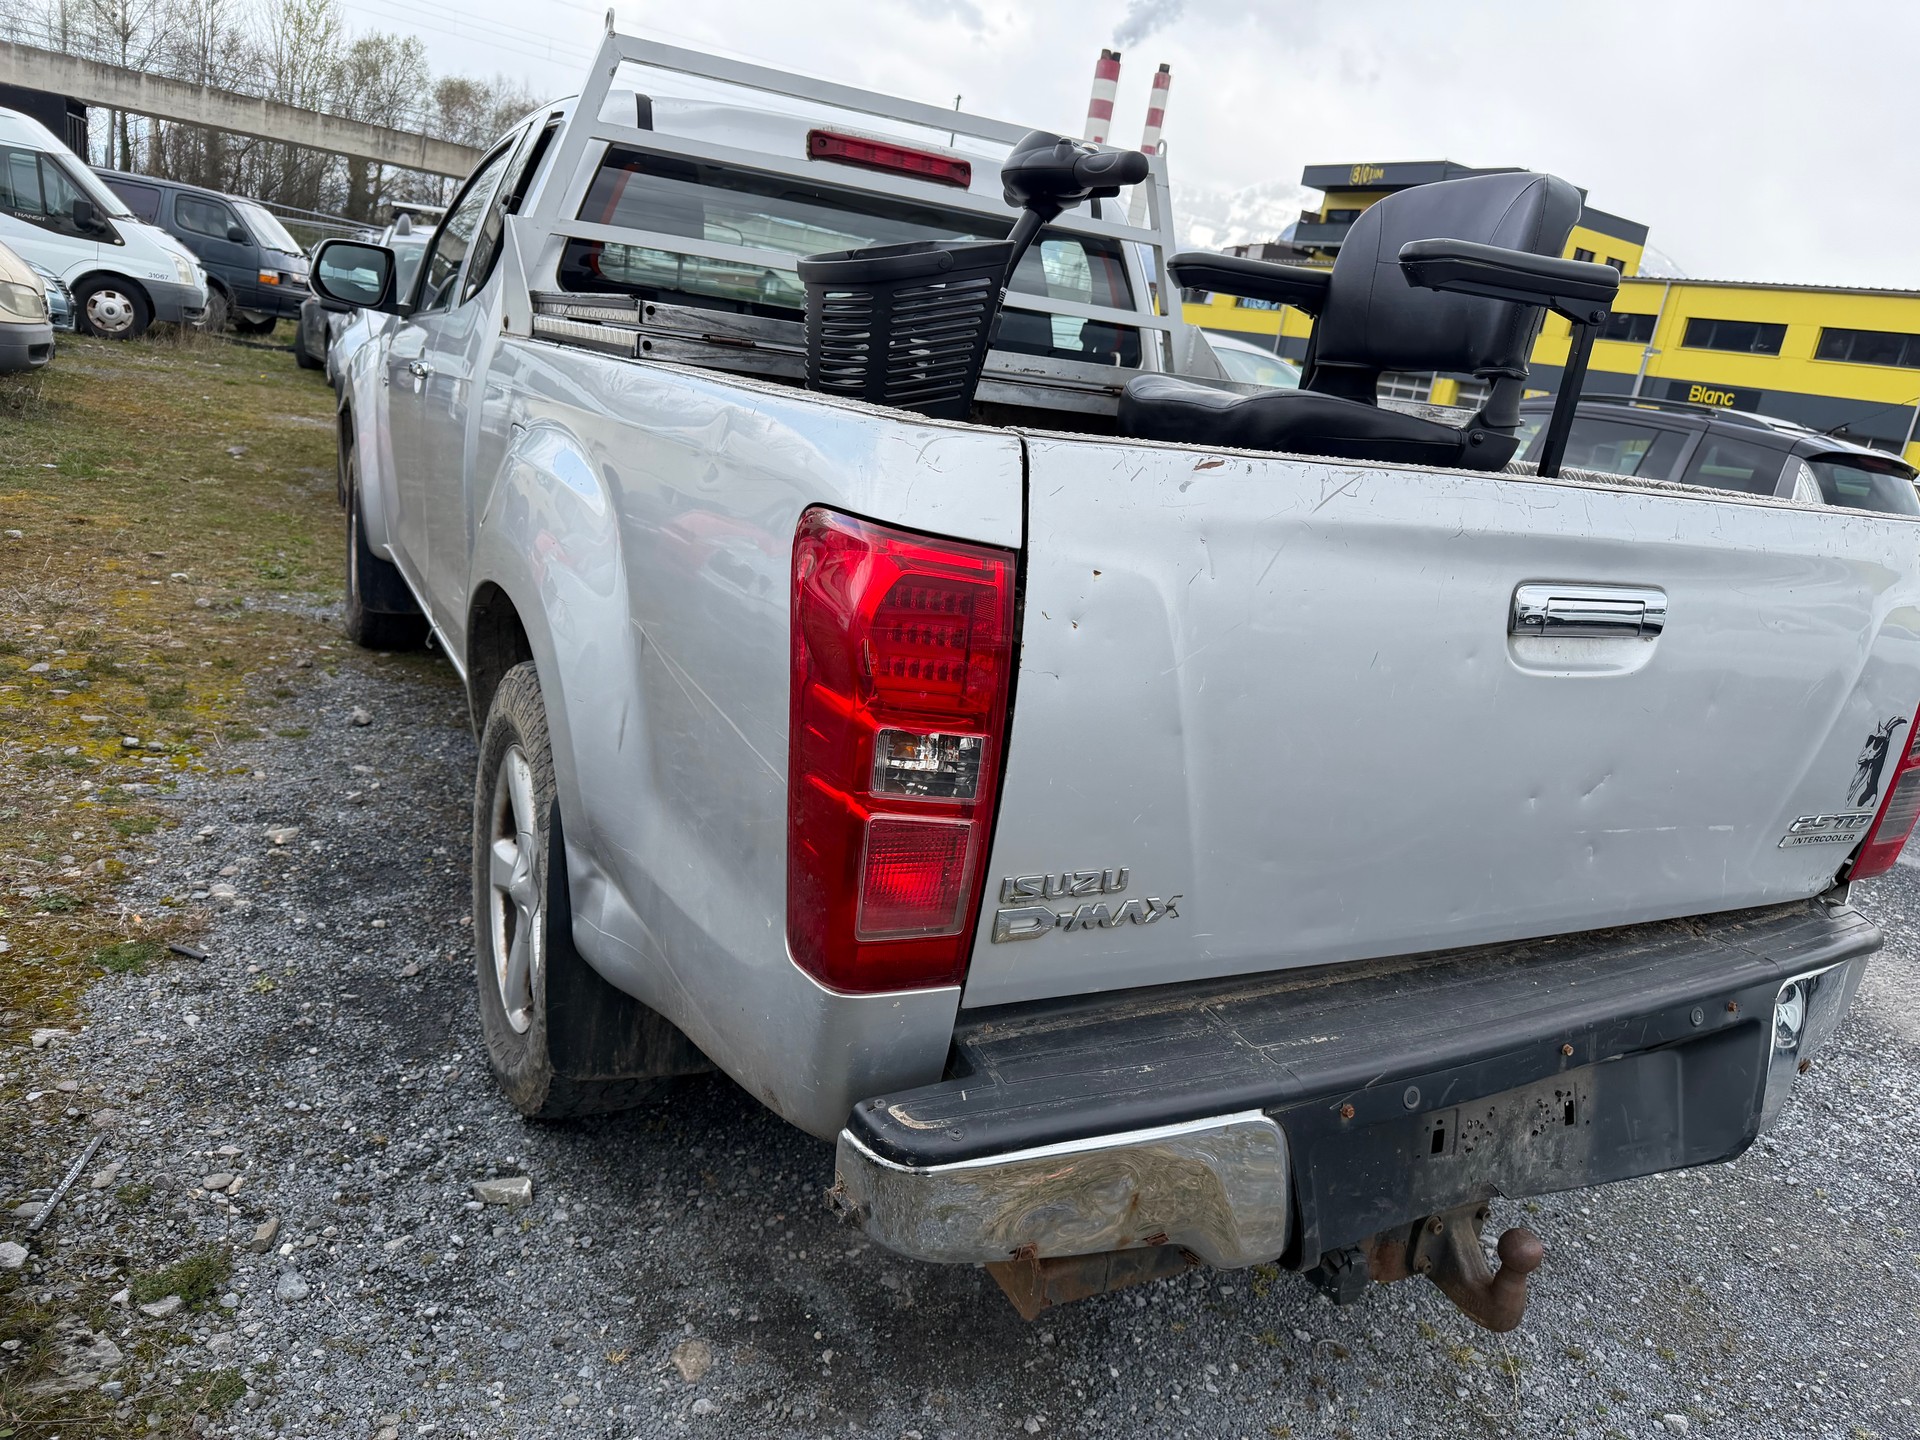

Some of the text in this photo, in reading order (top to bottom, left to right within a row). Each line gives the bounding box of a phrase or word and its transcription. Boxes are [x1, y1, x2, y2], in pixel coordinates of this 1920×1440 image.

[14, 211, 46, 222] TRANSIT
[147, 271, 169, 280] 31067
[1688, 384, 1735, 406] Blanc
[1792, 833, 1855, 845] INTERCOOLER
[1000, 866, 1129, 903] ISUZU
[991, 895, 1183, 944] D-MAX
